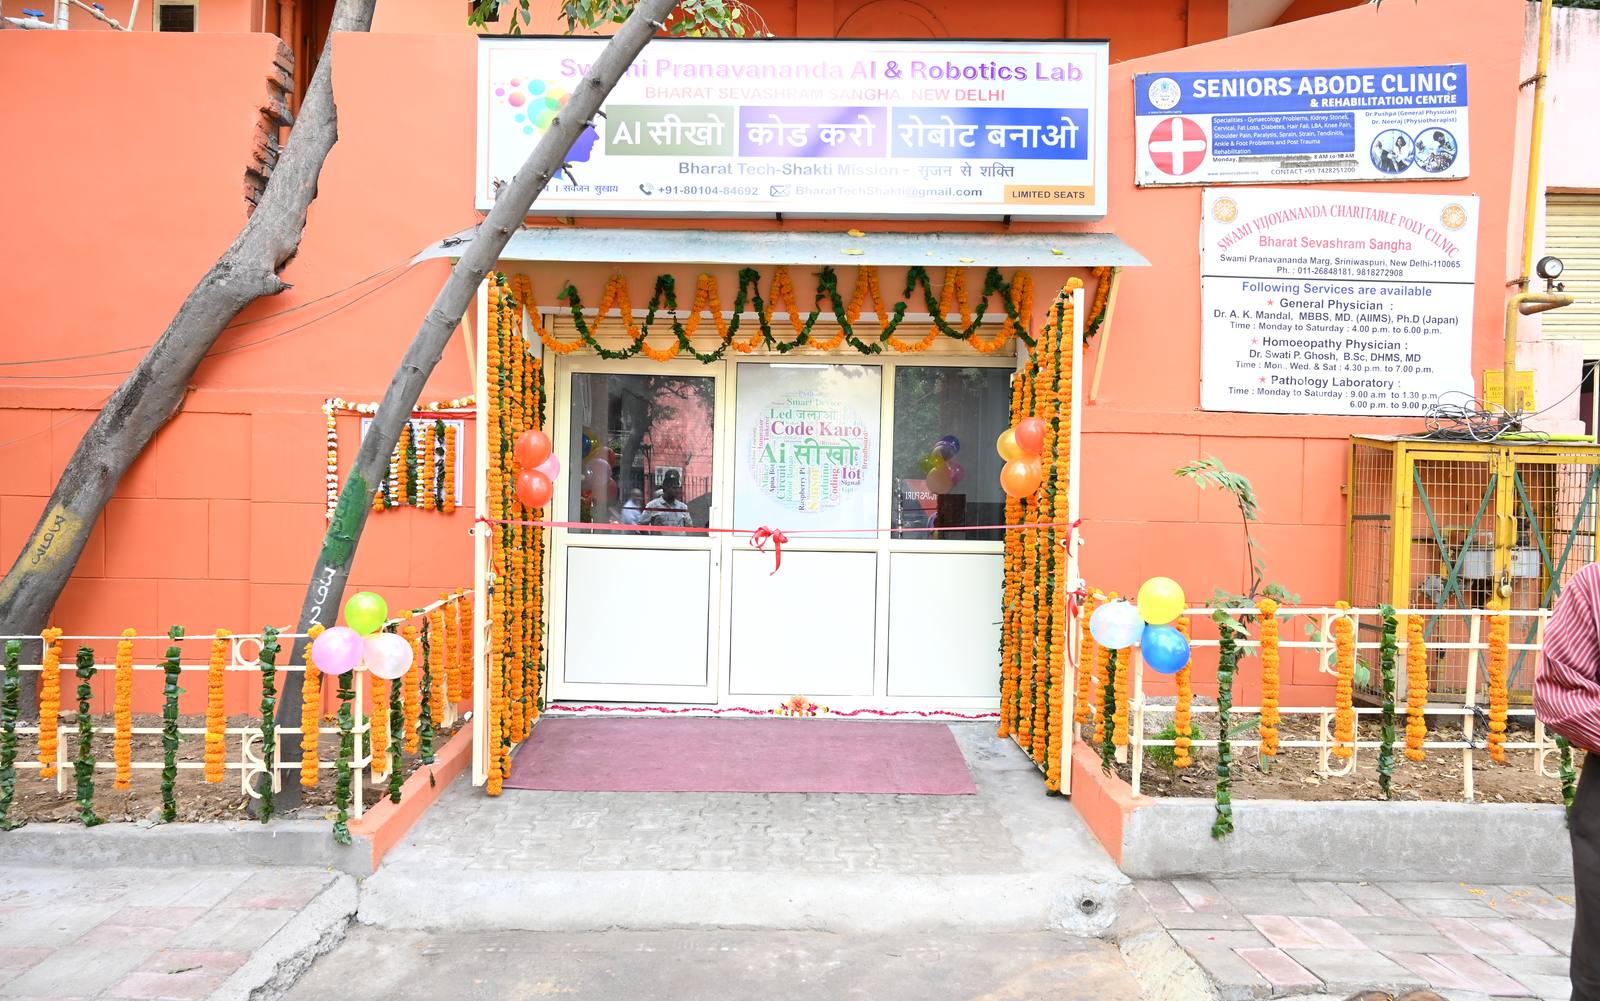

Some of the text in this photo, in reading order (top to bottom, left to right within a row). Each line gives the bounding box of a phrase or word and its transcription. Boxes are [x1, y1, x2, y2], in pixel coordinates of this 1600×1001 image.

[656, 59, 1083, 82] Pranavananda AI & Robotics Lab
[1192, 77, 1293, 98] SENIORS
[1297, 74, 1376, 96] ABODE
[1381, 72, 1458, 93] CLINIC
[645, 86, 714, 99] BHARAT
[719, 87, 824, 100] SEVASHRAM
[912, 89, 950, 101] NEW
[955, 89, 1005, 102] DELHI
[1309, 94, 1457, 108] & REHABILITATION CENTRE
[612, 113, 726, 147] AI सीखो
[745, 114, 876, 147] कोड करो
[897, 114, 1080, 149] रोबोट बनाओ
[678, 161, 1015, 181] Bharat Tech-Shakti Mission सृजन से शक्ति
[657, 186, 759, 196] +91-80104-84692
[1012, 190, 1086, 200] LIMITED SEATS
[1216, 203, 1460, 259] SWAMI VIJOYANANDA CHARITABLE POLY CILNIC
[1258, 235, 1412, 254] Bharat Sevashram Sangha
[1219, 254, 1248, 263] Swami
[1248, 255, 1308, 265] Pranavananda
[1389, 259, 1408, 267] New
[1409, 259, 1461, 268] Delhi-110065
[1276, 266, 1291, 274] Ph.
[1356, 268, 1404, 277] 9818272908
[1241, 281, 1432, 297] Following Services are available
[1279, 298, 1384, 313] General Physician
[1213, 309, 1227, 319] Dr.
[1229, 310, 1241, 319] A.
[1242, 310, 1253, 319] K.
[1255, 310, 1294, 321] Mandal,
[1396, 314, 1420, 324] Ph.D
[1422, 315, 1459, 326] (Japan)
[1230, 321, 1250, 330] Time
[1258, 322, 1292, 333] Monday
[1294, 323, 1304, 331] to
[1305, 324, 1345, 334] Saturday
[1351, 325, 1370, 333] 4.00
[1262, 337, 1402, 351] Homoeopathy Physician
[1249, 349, 1263, 359] Dr.
[1265, 350, 1291, 360] Swati
[1293, 351, 1303, 360] P.
[1404, 354, 1422, 363] MD
[1235, 360, 1256, 369] Time
[1313, 363, 1321, 371] &
[1322, 363, 1337, 372] Sat
[1344, 364, 1362, 372] 4.30
[1384, 364, 1394, 372] to
[1395, 365, 1413, 373] 7.00
[1270, 375, 1394, 390] Pathology Laboratory
[1228, 387, 1249, 395] Time
[1256, 388, 1292, 399] Monday
[1293, 389, 1302, 397] to
[1304, 389, 1343, 400] Saturday
[1350, 390, 1368, 398] 9.00
[1390, 391, 1400, 399] to
[1401, 391, 1420, 399] 1.30
[1349, 400, 1368, 409] 6.00
[1390, 401, 1400, 409] to
[1401, 401, 1420, 410] 9.00
[770, 408, 792, 420] Led
[771, 420, 814, 436] Code
[819, 421, 862, 437] Karo
[758, 442, 786, 464] Ai
[793, 437, 861, 466] सीखो
[841, 467, 862, 480] Iot
[777, 465, 786, 500] Circuit
[830, 468, 839, 501] Coding
[798, 477, 807, 511] Raspberry
[308, 566, 337, 625] 392
